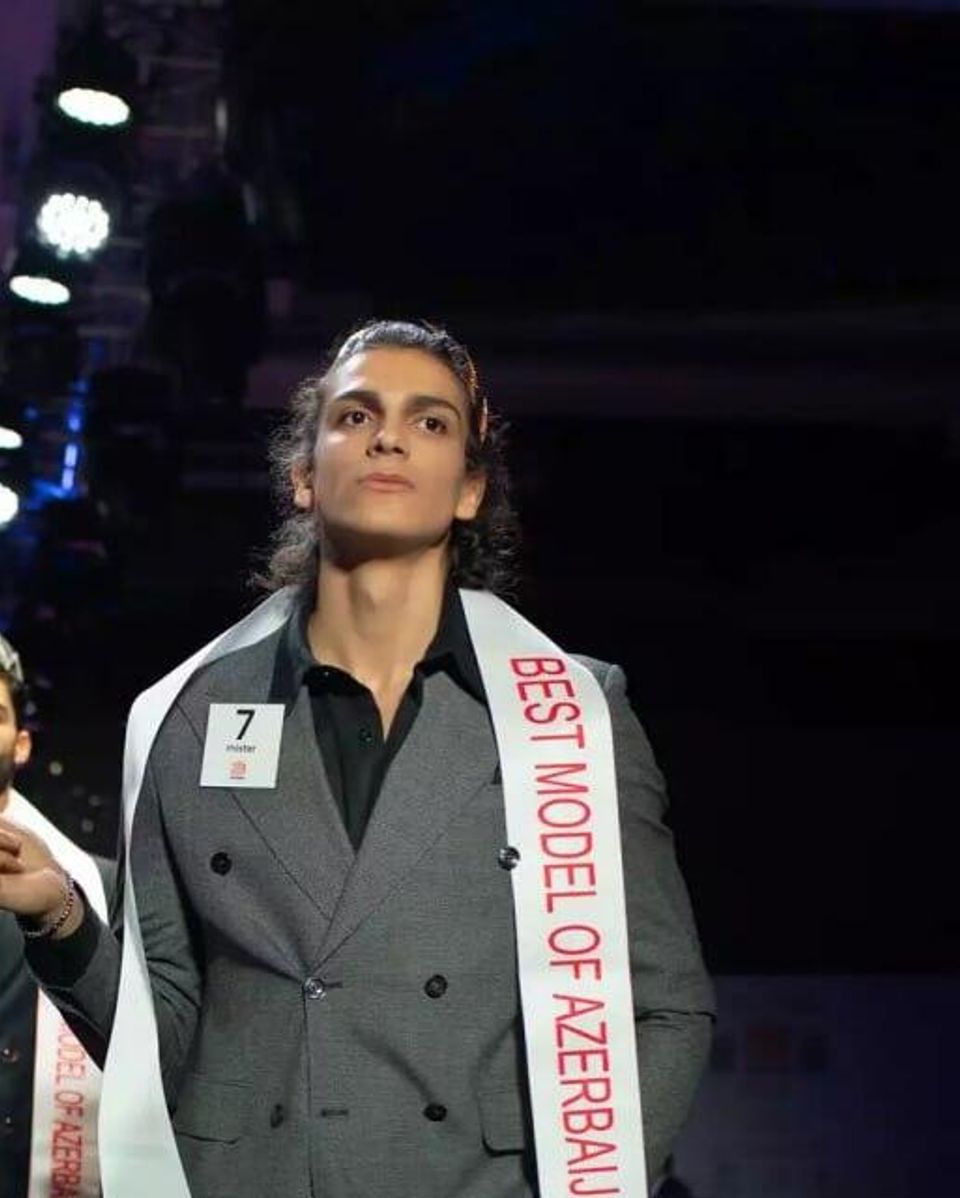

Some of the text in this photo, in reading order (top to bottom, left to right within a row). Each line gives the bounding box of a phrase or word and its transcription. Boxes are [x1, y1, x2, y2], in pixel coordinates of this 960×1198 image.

[236, 708, 256, 740] 7
[509, 656, 586, 749] BEST
[535, 762, 597, 914] MODEL
[547, 924, 603, 982] OF
[55, 1022, 87, 1086] ODEL
[53, 1090, 84, 1118] OF
